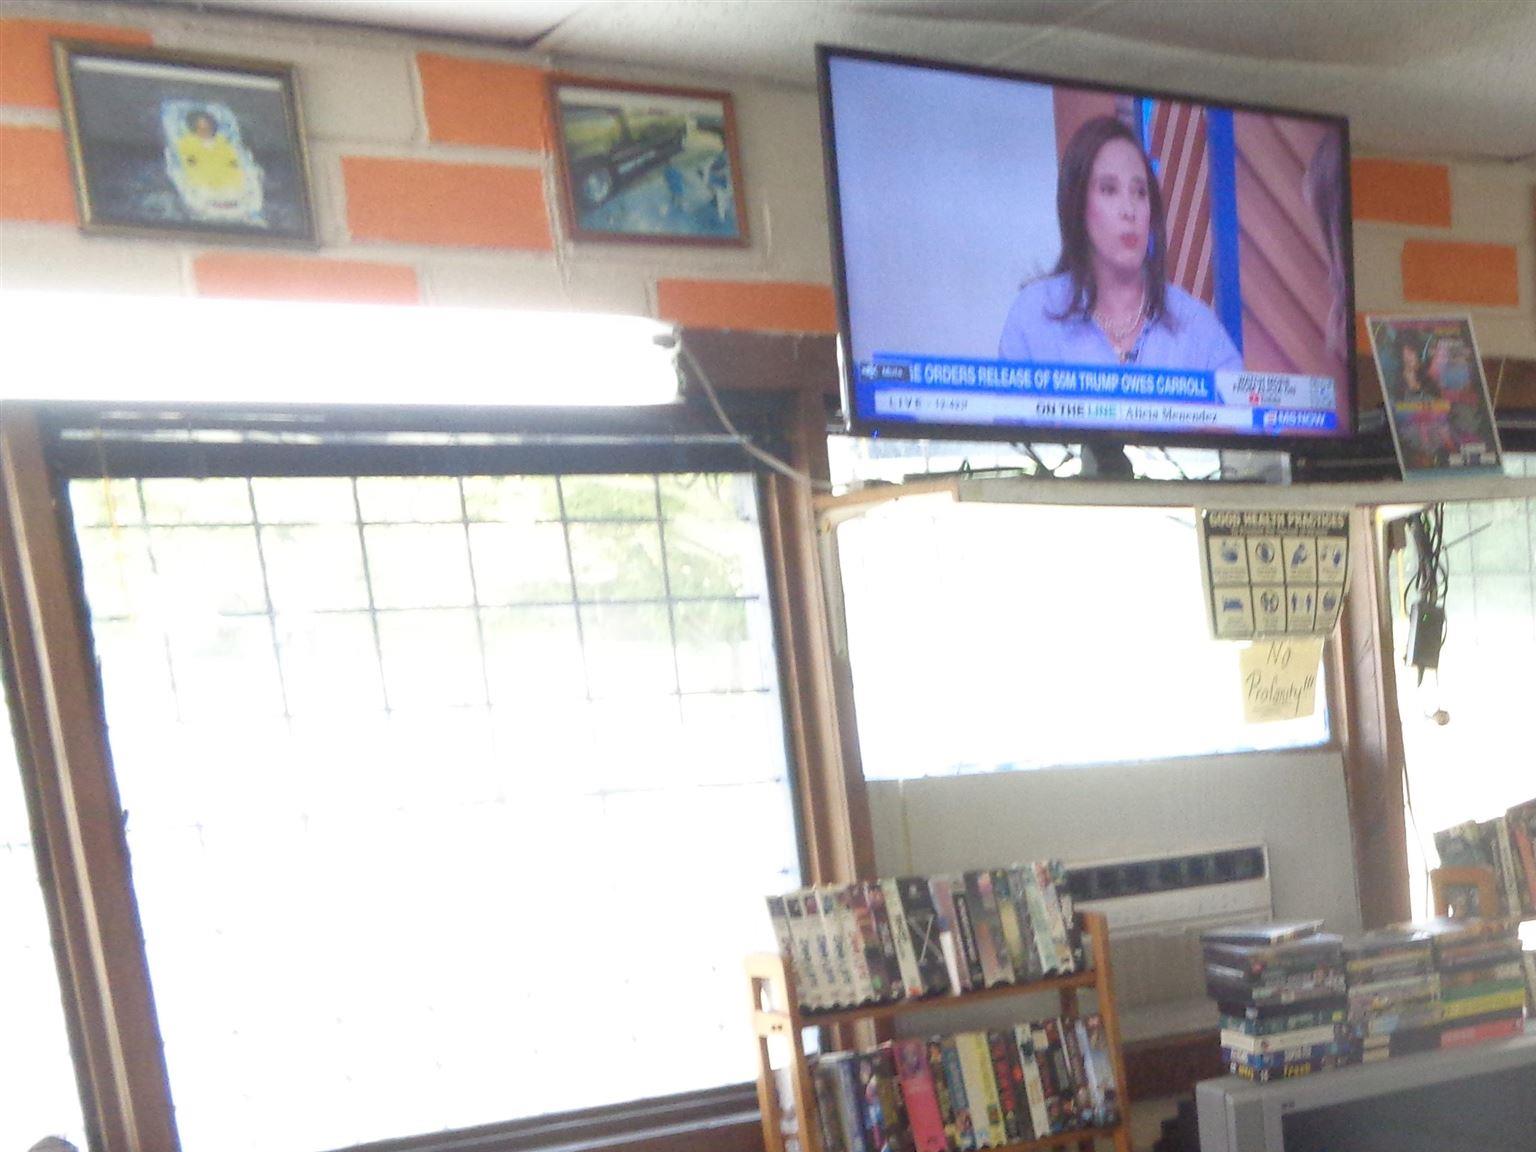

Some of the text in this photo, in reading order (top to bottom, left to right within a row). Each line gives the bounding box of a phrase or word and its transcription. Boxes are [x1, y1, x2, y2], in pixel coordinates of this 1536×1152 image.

[925, 363, 975, 385] ORDERS
[978, 365, 1031, 388] RELEASE
[1033, 367, 1051, 389] OF
[1079, 370, 1118, 392] TRUMP
[1121, 372, 1153, 394] OWES
[1156, 374, 1208, 397] CARROLL
[1059, 403, 1085, 417] THE
[1266, 641, 1292, 669] No
